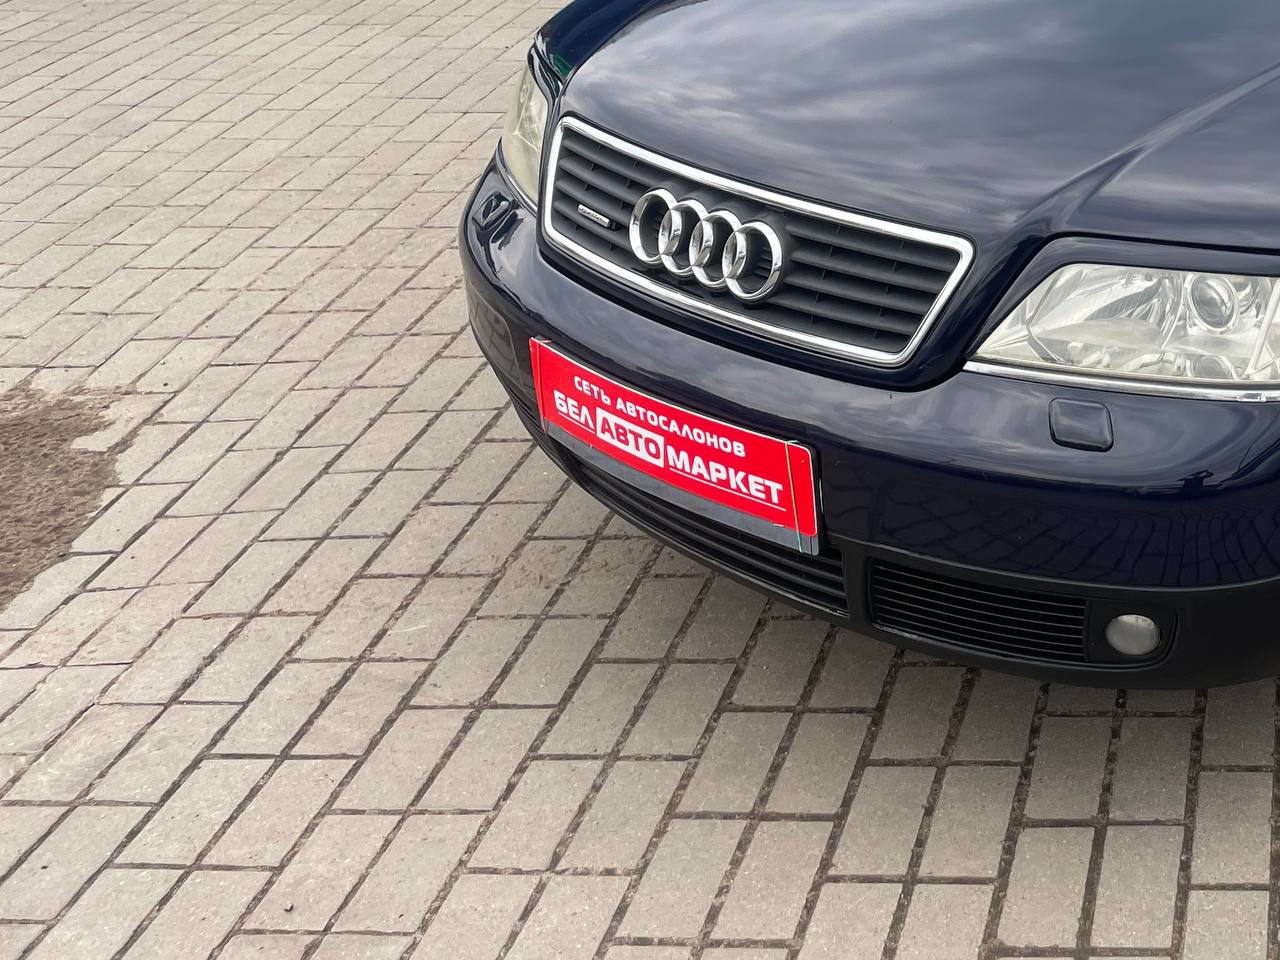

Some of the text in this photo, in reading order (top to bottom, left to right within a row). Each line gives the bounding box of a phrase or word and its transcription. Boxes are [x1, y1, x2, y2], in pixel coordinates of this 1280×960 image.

[553, 389, 784, 505] БЕЛ АВТО МАРКЕТ
[573, 375, 747, 458] СЕТЬ АВТОСАЛОНОВ
